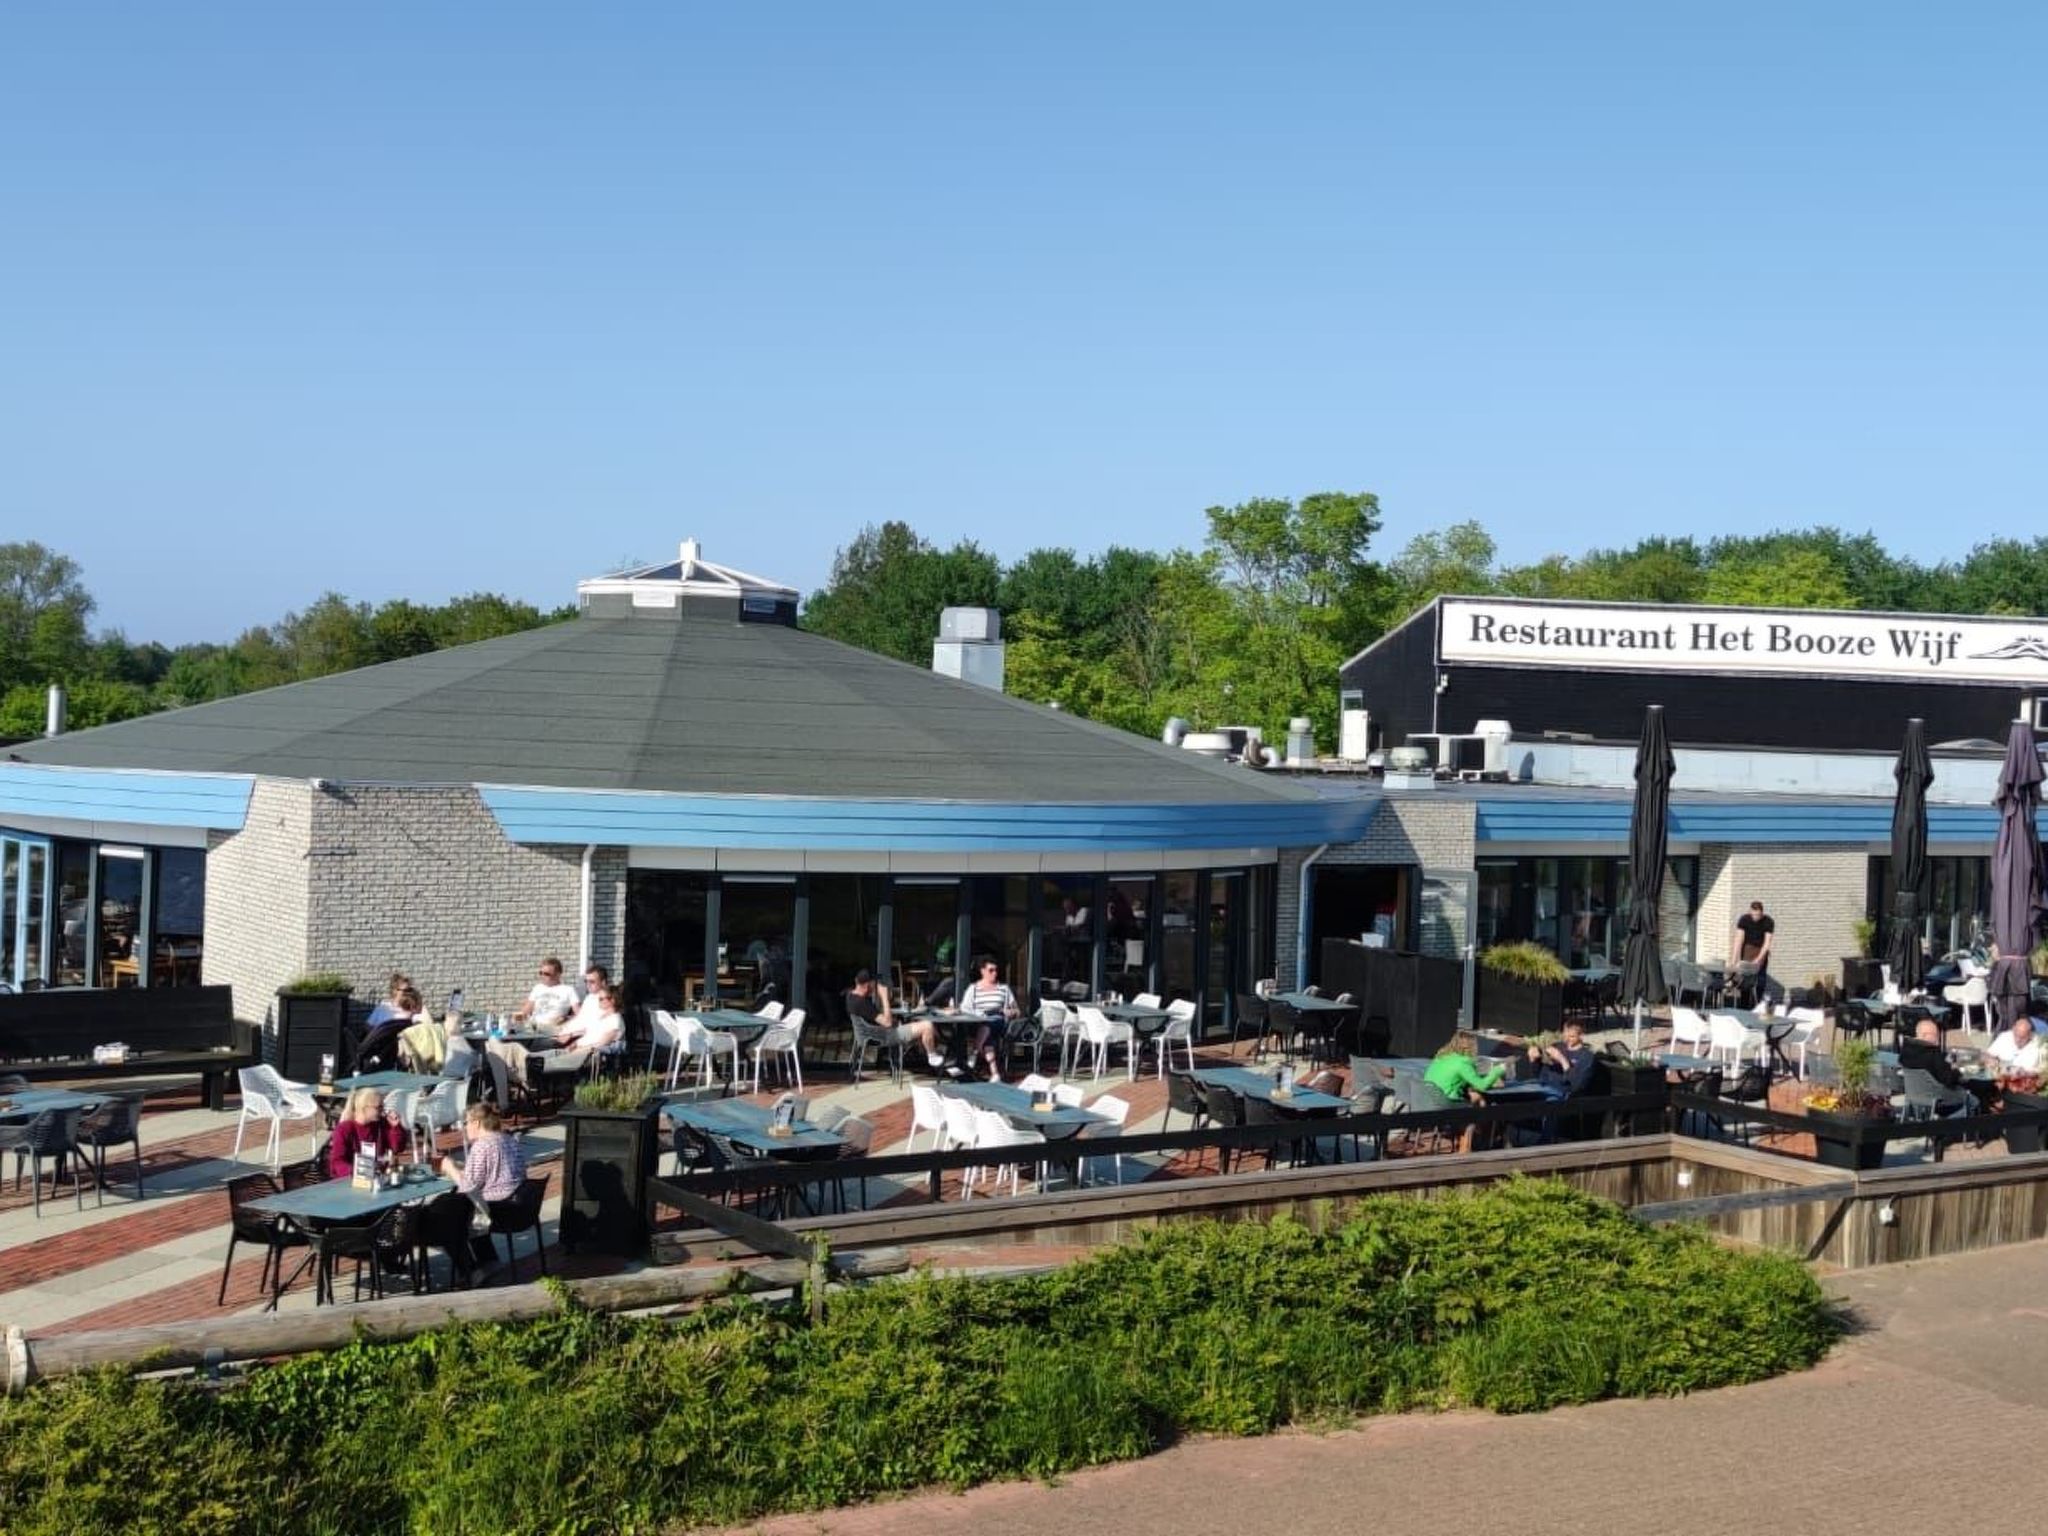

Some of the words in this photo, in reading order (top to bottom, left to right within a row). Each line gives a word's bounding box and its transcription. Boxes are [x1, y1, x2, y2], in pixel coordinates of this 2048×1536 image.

[1469, 614, 1676, 650] Restaurant
[1690, 623, 1754, 651] Het
[1767, 624, 1875, 655] Booze
[1888, 629, 1962, 665] Wijf
